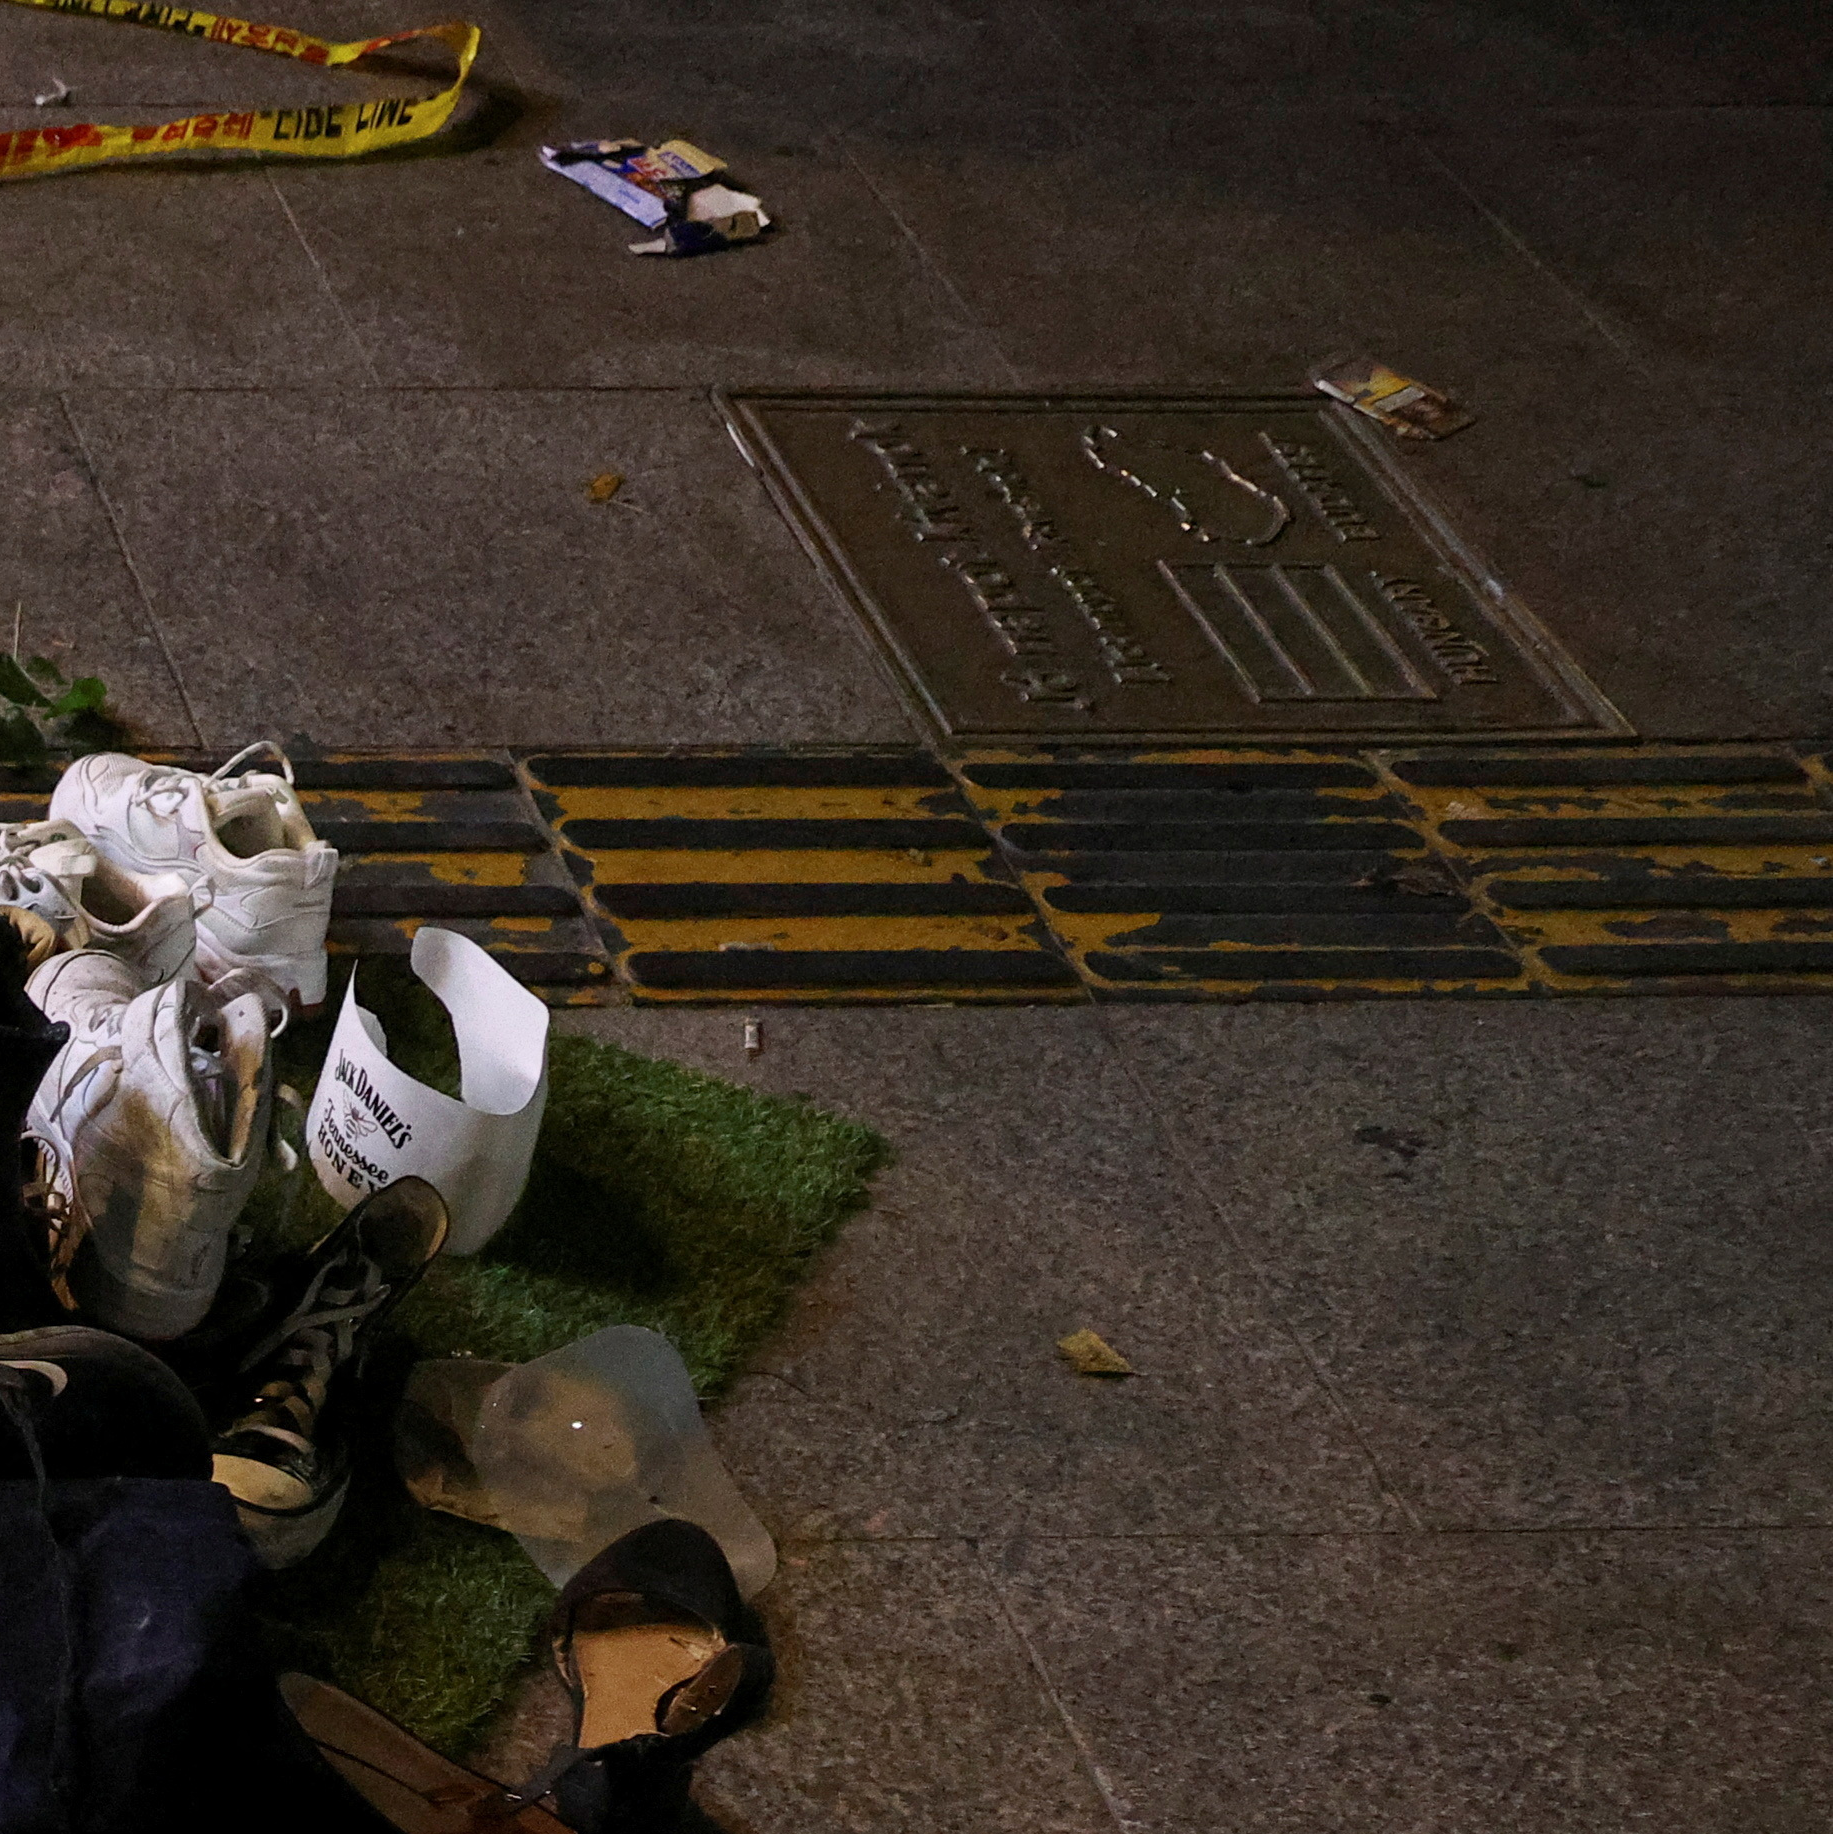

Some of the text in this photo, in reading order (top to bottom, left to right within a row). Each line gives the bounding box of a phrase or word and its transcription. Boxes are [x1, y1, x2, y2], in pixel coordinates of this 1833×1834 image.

[324, 1098, 389, 1184] Tennessee
[335, 1048, 413, 1149] JACK DANIEL'S
